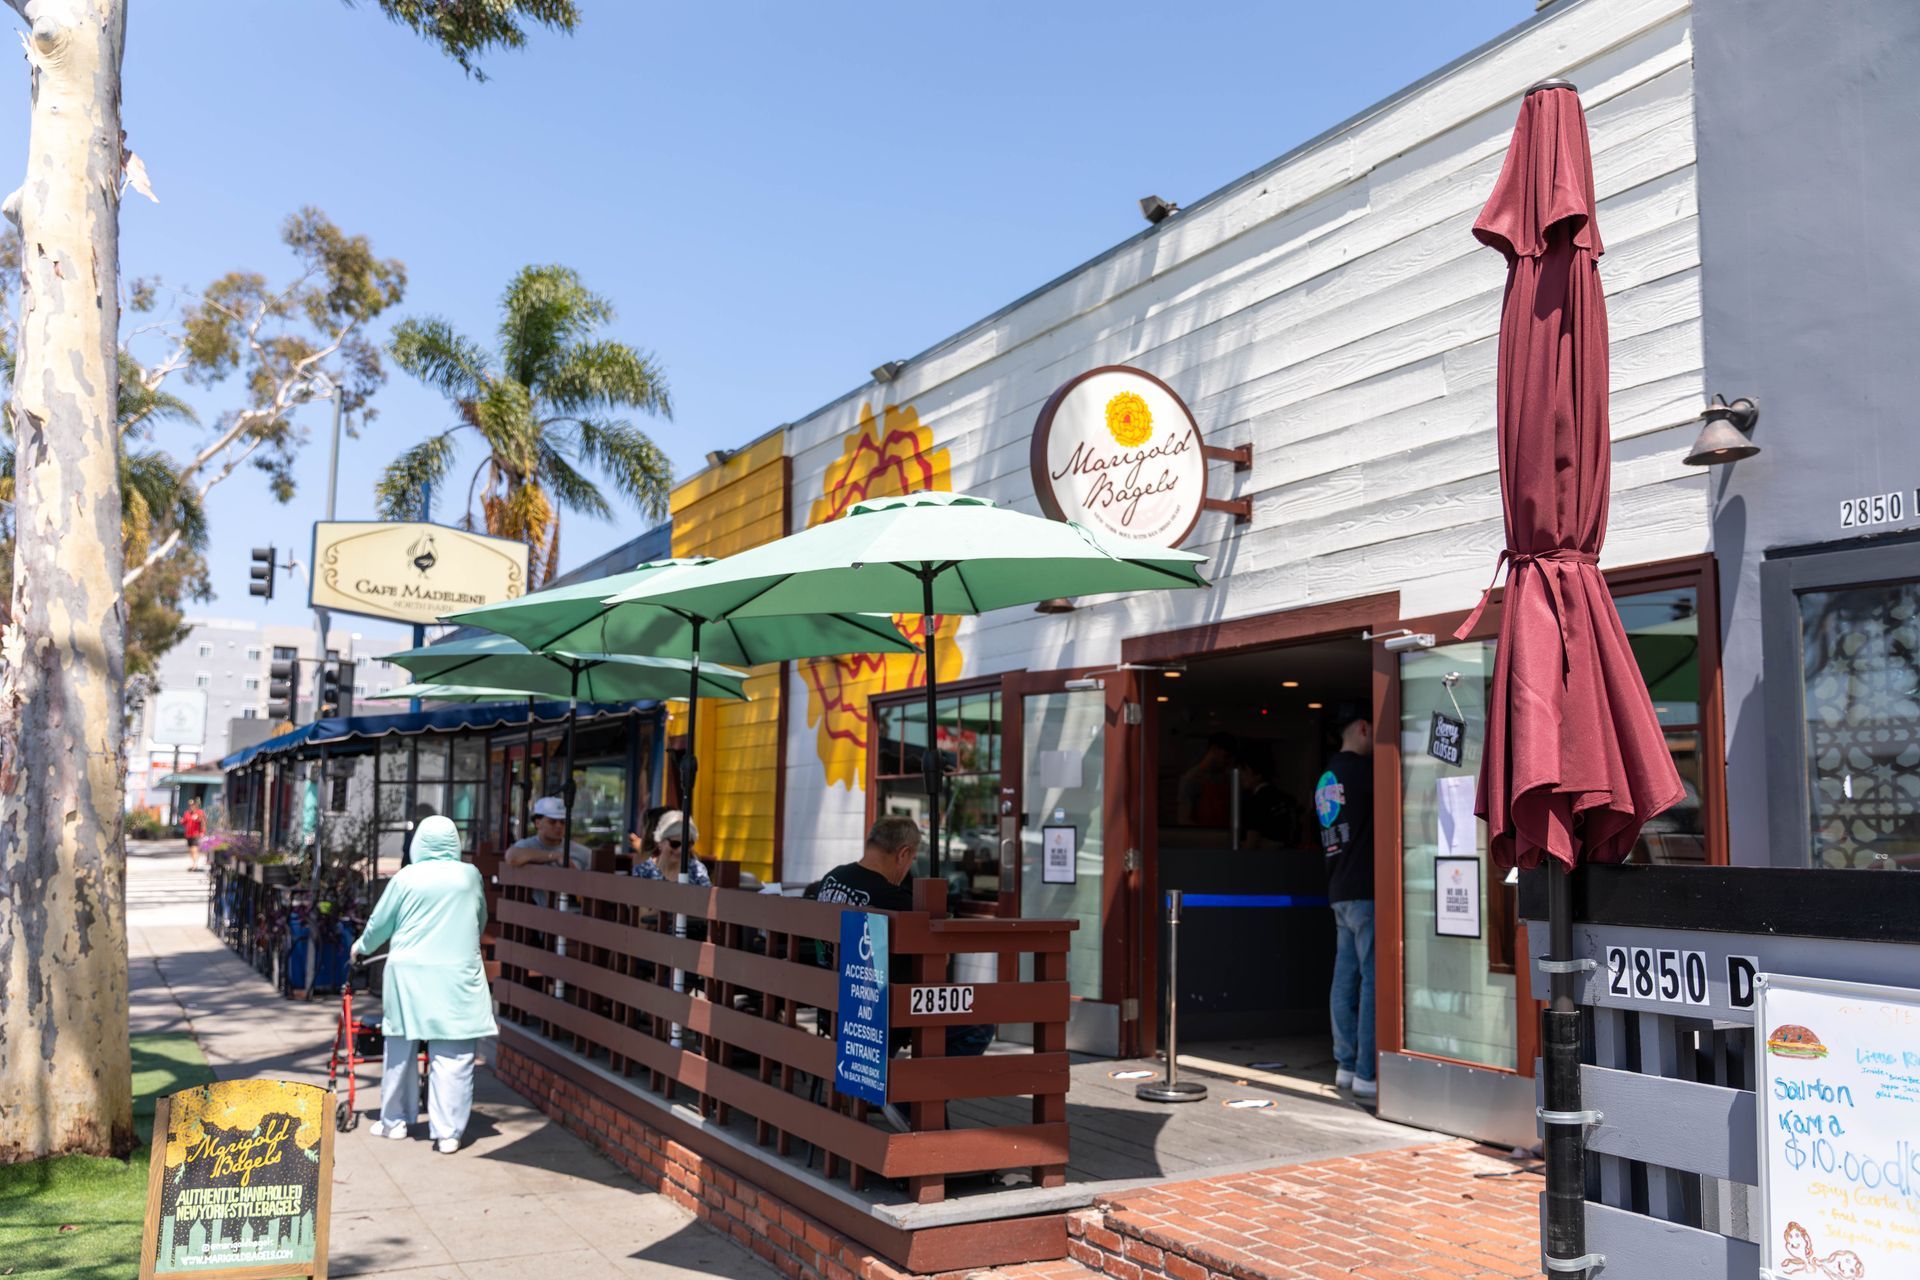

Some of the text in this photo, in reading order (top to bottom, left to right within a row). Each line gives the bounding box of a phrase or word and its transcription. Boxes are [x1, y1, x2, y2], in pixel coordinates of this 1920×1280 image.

[1052, 429, 1193, 490] Marigold
[1082, 469, 1179, 527] Bagels
[1843, 494, 1901, 526] 2850
[1433, 741, 1457, 762] CLOSED
[845, 963, 884, 985] ACCESSIBLE
[1609, 948, 1757, 1007] 2850 D
[851, 984, 880, 1003] PARKING
[912, 987, 972, 1013] 2850C
[858, 1005, 873, 1021] AND
[843, 1021, 884, 1045] ACCESSIBLE
[845, 1041, 880, 1064] ENTRANCE
[851, 1061, 880, 1079] AROUND BACK
[188, 1119, 290, 1166] Marigold
[210, 1142, 282, 1187] Bagels
[175, 1188, 239, 1206] AUTHENTIC
[175, 1204, 199, 1221] NEW
[263, 1200, 302, 1217] BAGELS
